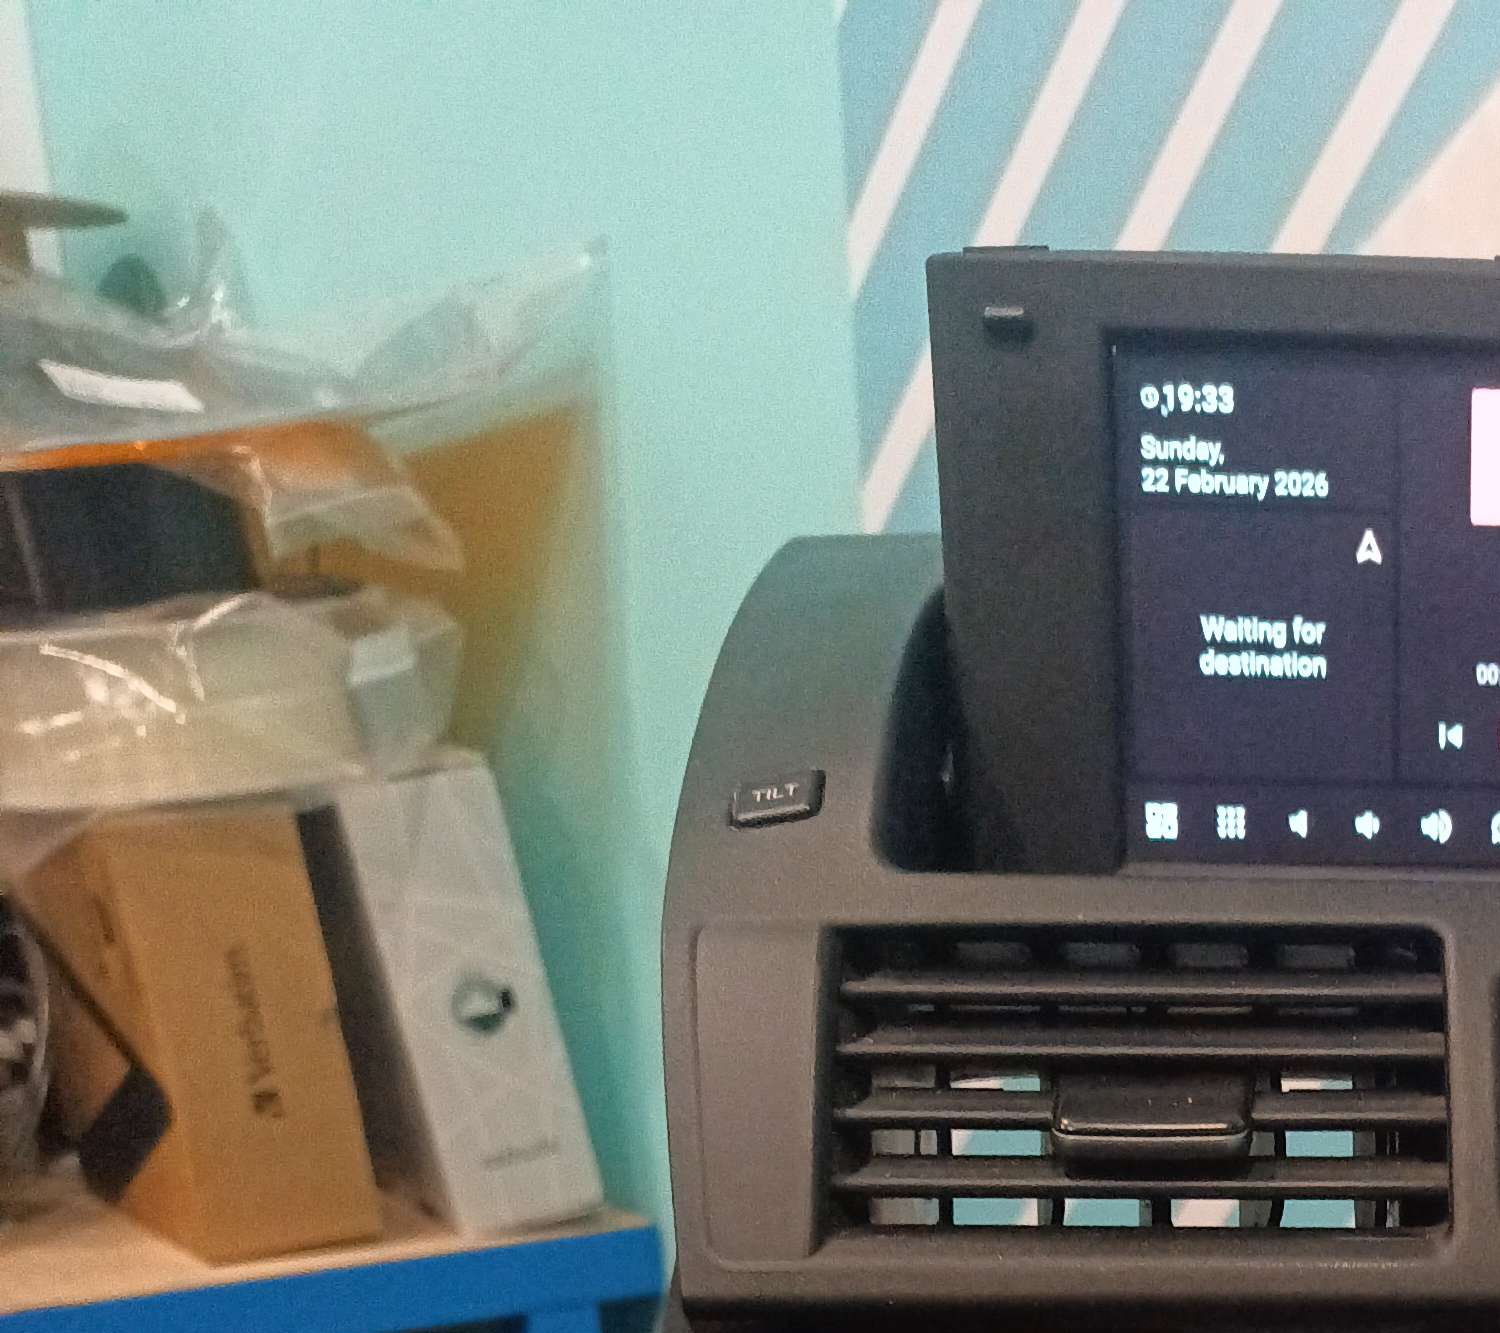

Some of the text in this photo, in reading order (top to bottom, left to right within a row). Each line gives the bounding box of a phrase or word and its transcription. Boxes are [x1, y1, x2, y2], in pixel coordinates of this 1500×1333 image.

[1163, 383, 1235, 414] 19:33
[1140, 433, 1225, 465] Sunday,
[1141, 468, 1330, 502] 22 February 2026
[1200, 614, 1327, 649] Waiting for
[1199, 648, 1328, 680] destination
[752, 783, 800, 802] TILT
